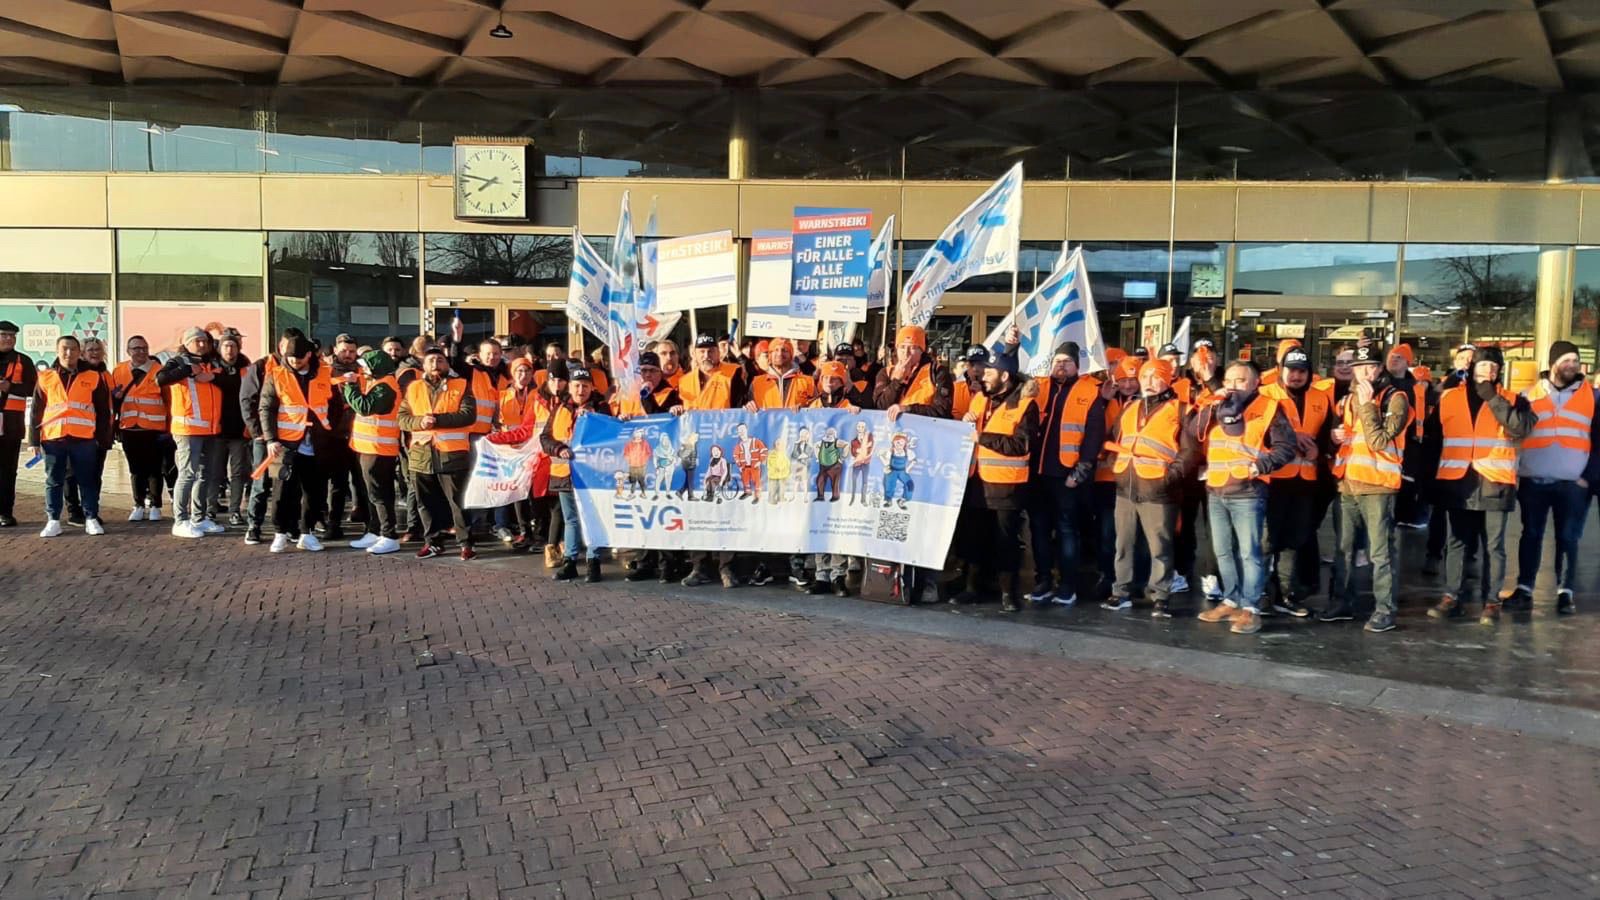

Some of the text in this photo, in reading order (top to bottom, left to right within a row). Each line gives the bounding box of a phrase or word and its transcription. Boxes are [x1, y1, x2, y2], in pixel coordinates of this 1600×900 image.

[798, 216, 867, 230] WARNSTREIK!
[756, 240, 793, 251] WARNST
[815, 235, 852, 249] EINER
[797, 249, 820, 264] FÜR
[822, 248, 854, 262] ALLE
[812, 263, 844, 277] ALLE
[795, 276, 864, 291] FÜR EINEN!
[751, 320, 773, 330] EVG
[1286, 352, 1307, 361] EVG
[613, 503, 684, 532] EVG
